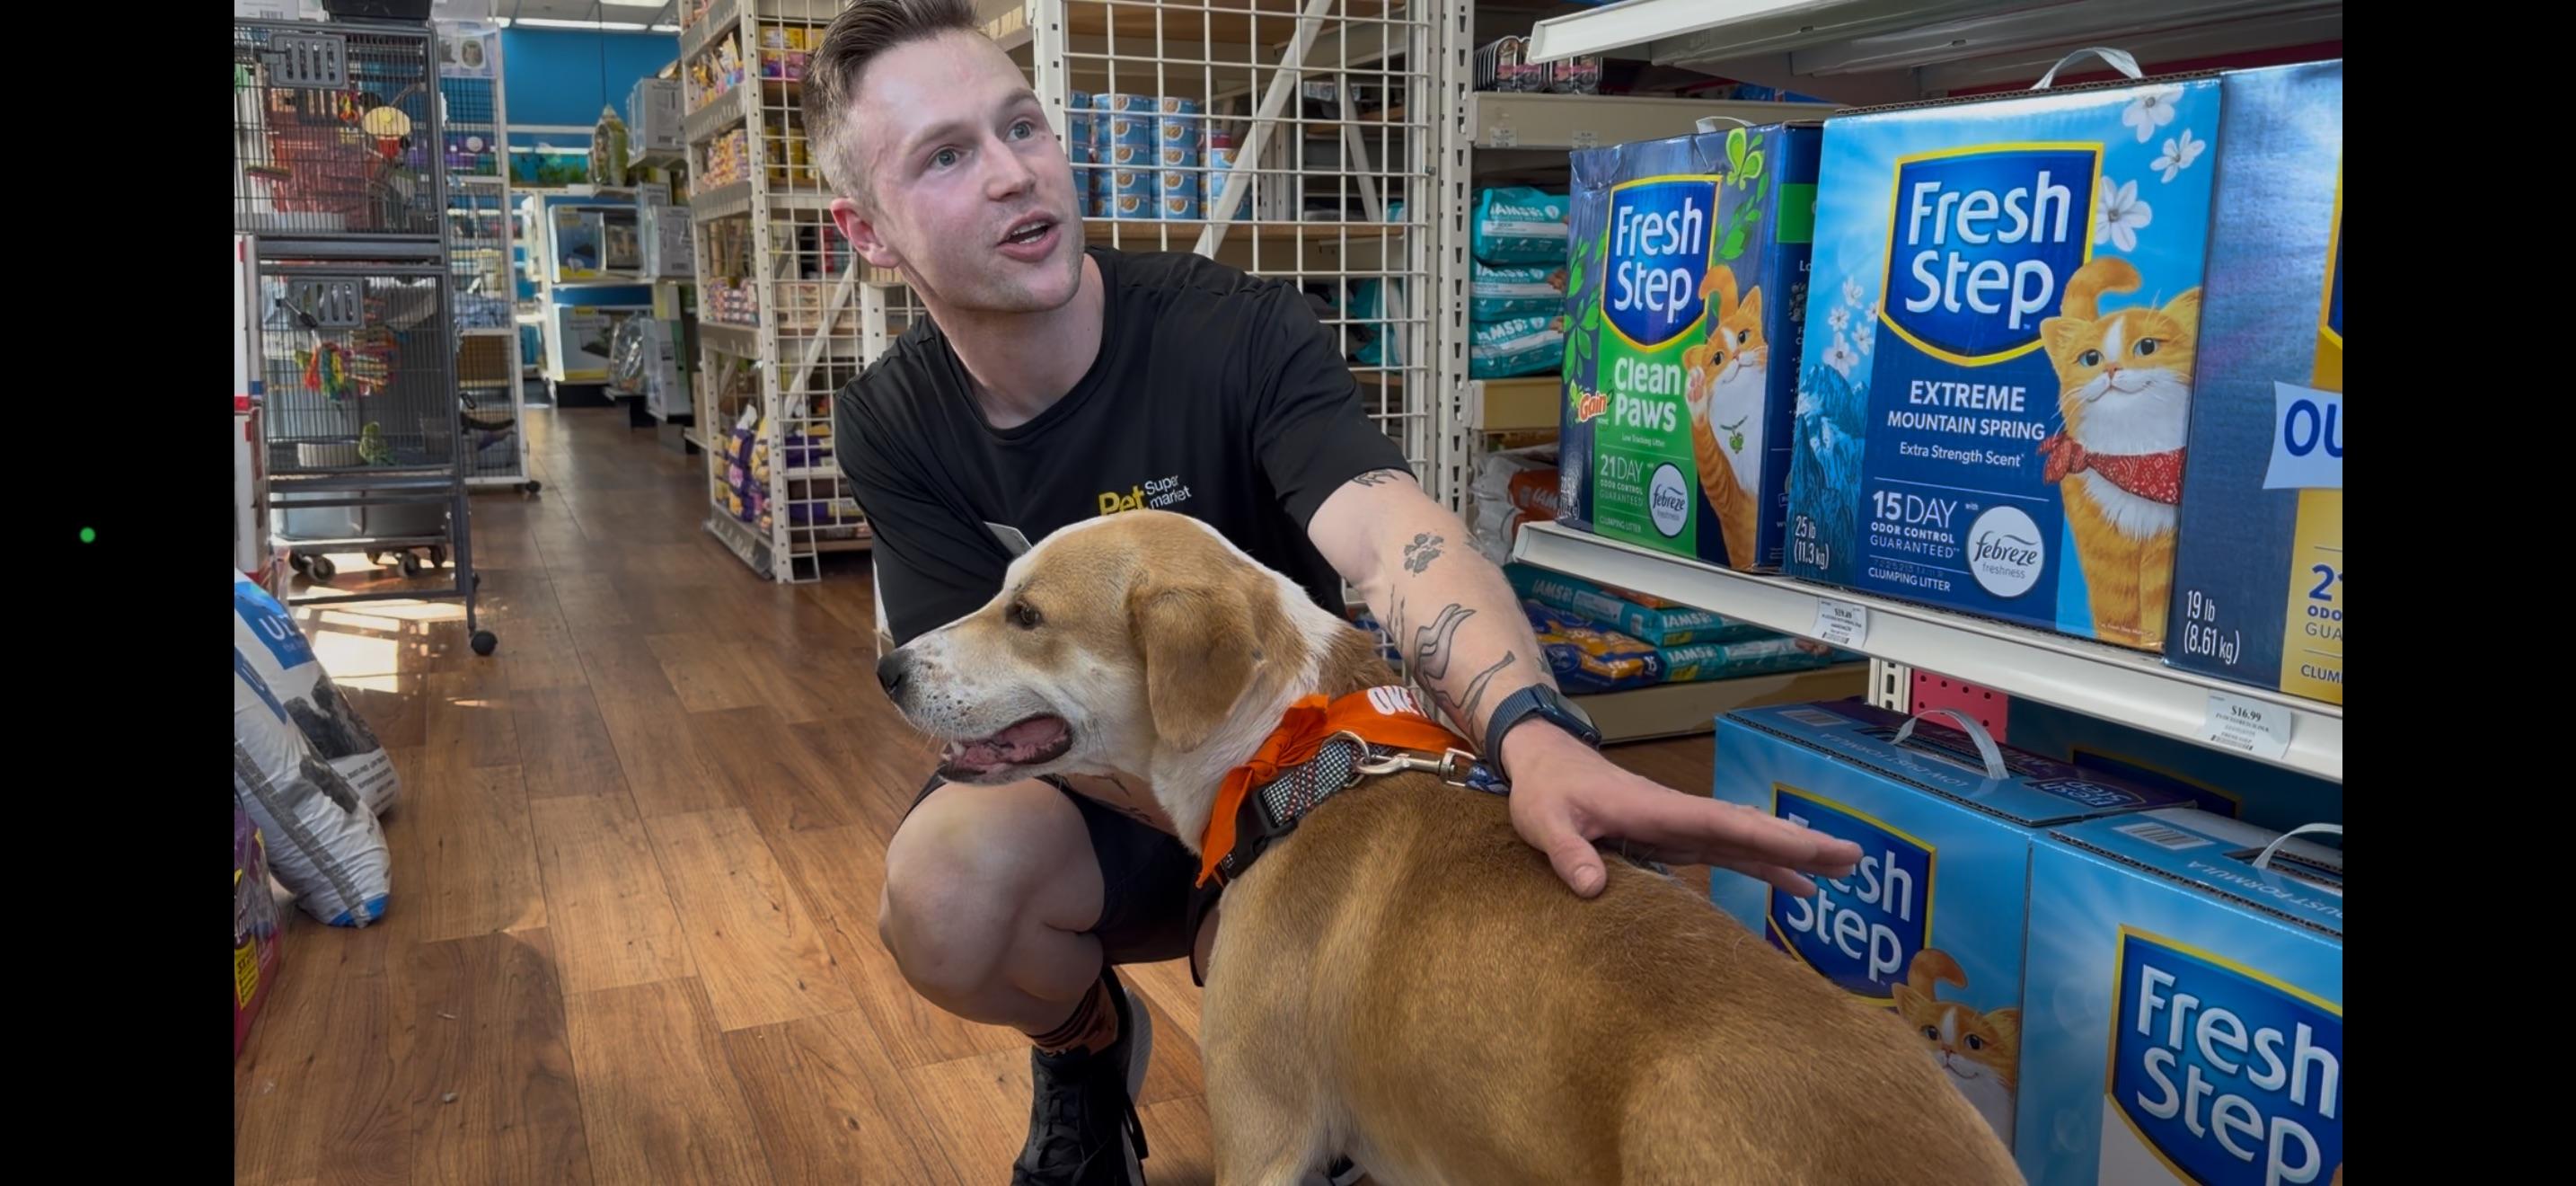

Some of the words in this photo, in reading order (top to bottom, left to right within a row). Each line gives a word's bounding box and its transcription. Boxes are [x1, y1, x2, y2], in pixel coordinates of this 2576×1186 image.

[1908, 170, 2071, 245] Fresh
[1615, 195, 1703, 257] Fresh
[1613, 261, 1692, 323] Step
[1905, 250, 2054, 330] Step
[1614, 356, 1681, 396] Clean
[1578, 391, 1608, 423] Gain
[1909, 380, 2026, 412] EXTREME
[1614, 393, 1677, 432] Paws
[1887, 411, 1976, 435] MOUNTAIN
[1980, 419, 2046, 440] SPRING
[1601, 454, 1616, 478] 21
[1617, 456, 1644, 482] DAY
[1900, 441, 1929, 456] Extra
[1931, 445, 1983, 465] Strength
[1098, 485, 1145, 516] Pet
[1144, 474, 1178, 496] Super
[1150, 486, 1192, 509] market
[1653, 483, 1686, 511] febreze
[1872, 491, 1902, 520] 15
[1905, 494, 1958, 528] DAY
[1795, 515, 1808, 538] 25
[1808, 521, 1816, 539] lb
[1871, 521, 1901, 535] ODOR
[1904, 527, 1954, 544] CONTROL
[1794, 538, 1815, 564] (11.3
[1815, 543, 1830, 571] kg)
[1974, 530, 2038, 567] febreze
[1868, 567, 1919, 587] CLUMPING
[1919, 577, 1951, 593] LITTER
[1982, 562, 2026, 580] freshness
[2187, 589, 2201, 620] 19
[2203, 597, 2216, 624] lb
[2184, 621, 2218, 657] (8.61
[2219, 629, 2240, 666] kg)
[2300, 664, 2342, 686] CLUM
[2231, 704, 2263, 721] $16.99
[2187, 860, 2294, 899] FORMULA
[1786, 889, 1903, 984] Step
[2137, 963, 2340, 1120] Fresh
[2136, 1046, 2322, 1186] Step
